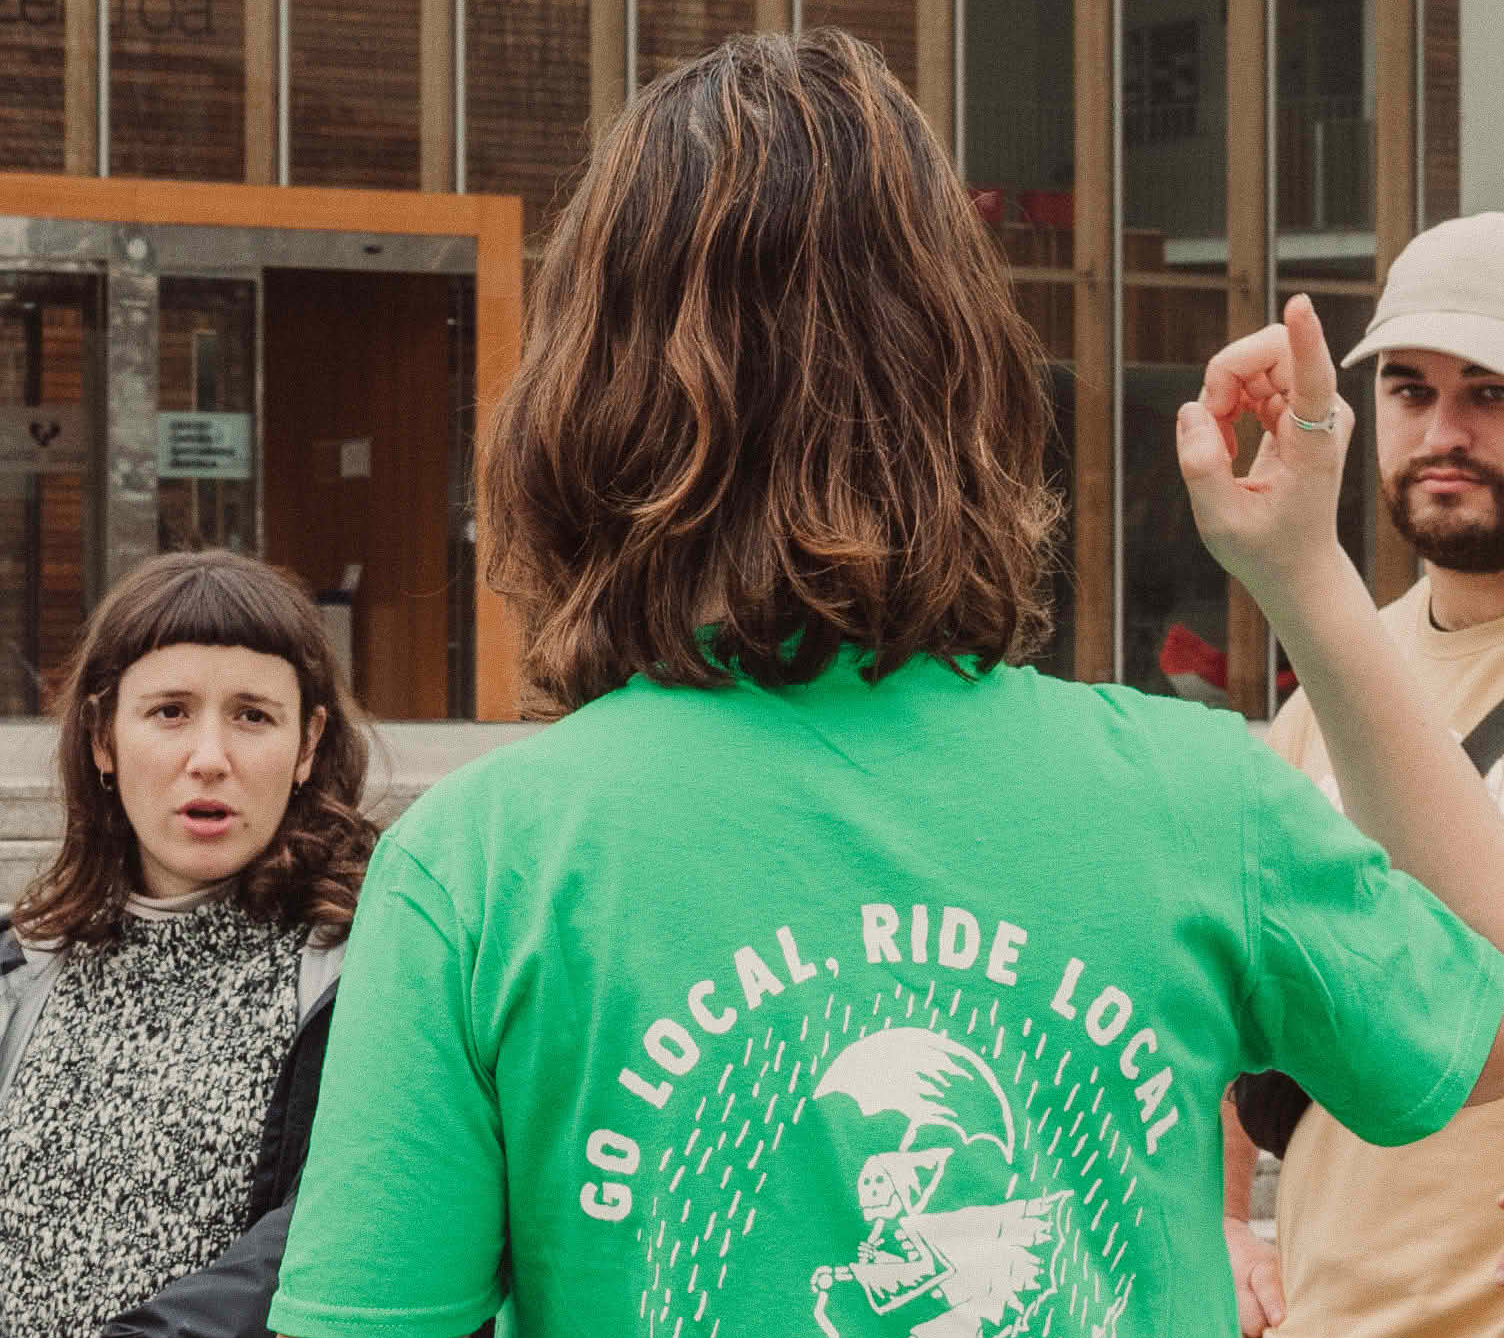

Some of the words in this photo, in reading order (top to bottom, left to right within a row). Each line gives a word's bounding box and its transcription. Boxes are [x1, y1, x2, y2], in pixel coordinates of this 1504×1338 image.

[579, 1128, 642, 1223] GO
[618, 925, 841, 1111] LOCAL,
[860, 903, 1028, 986] RIDE
[1050, 956, 1180, 1156] LOCAL
